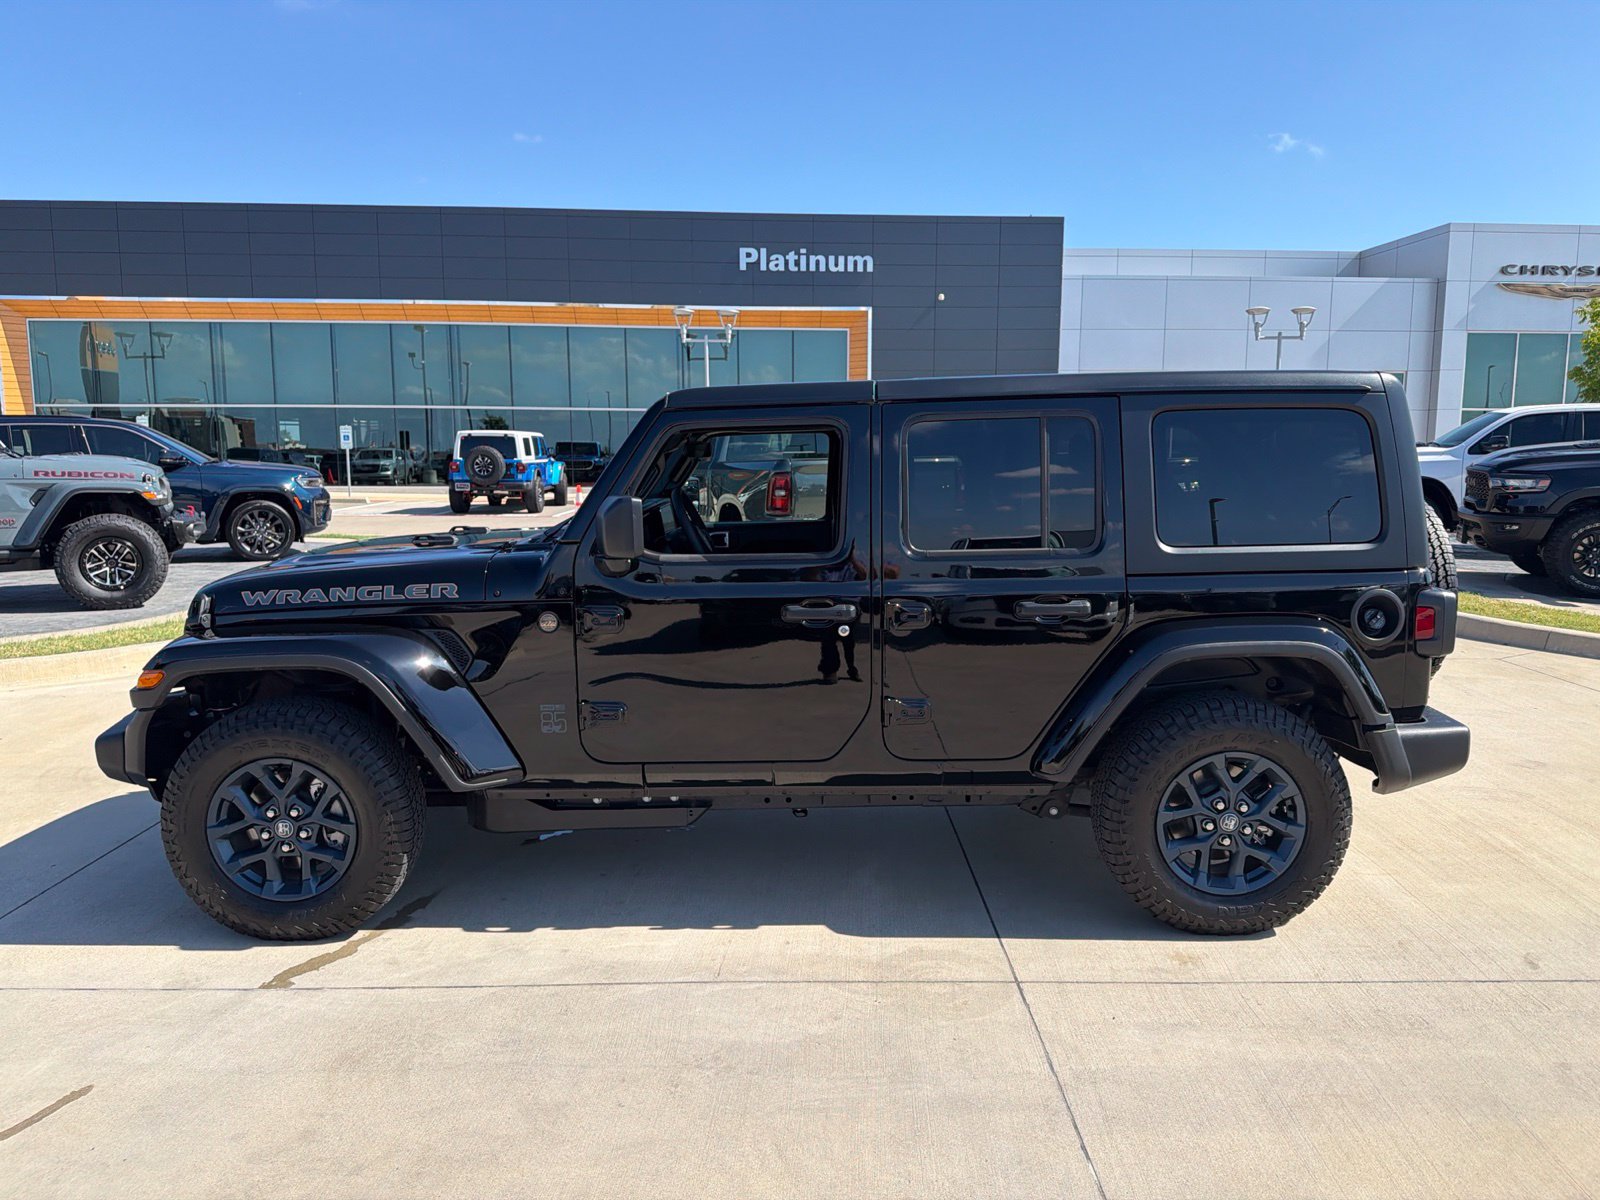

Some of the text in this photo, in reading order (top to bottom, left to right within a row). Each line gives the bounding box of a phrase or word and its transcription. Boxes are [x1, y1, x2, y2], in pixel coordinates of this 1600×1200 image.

[738, 247, 874, 272] Platinum
[1500, 264, 1600, 276] CHRYS
[33, 470, 135, 479] RUBICON
[241, 582, 459, 606] WRANGLER
